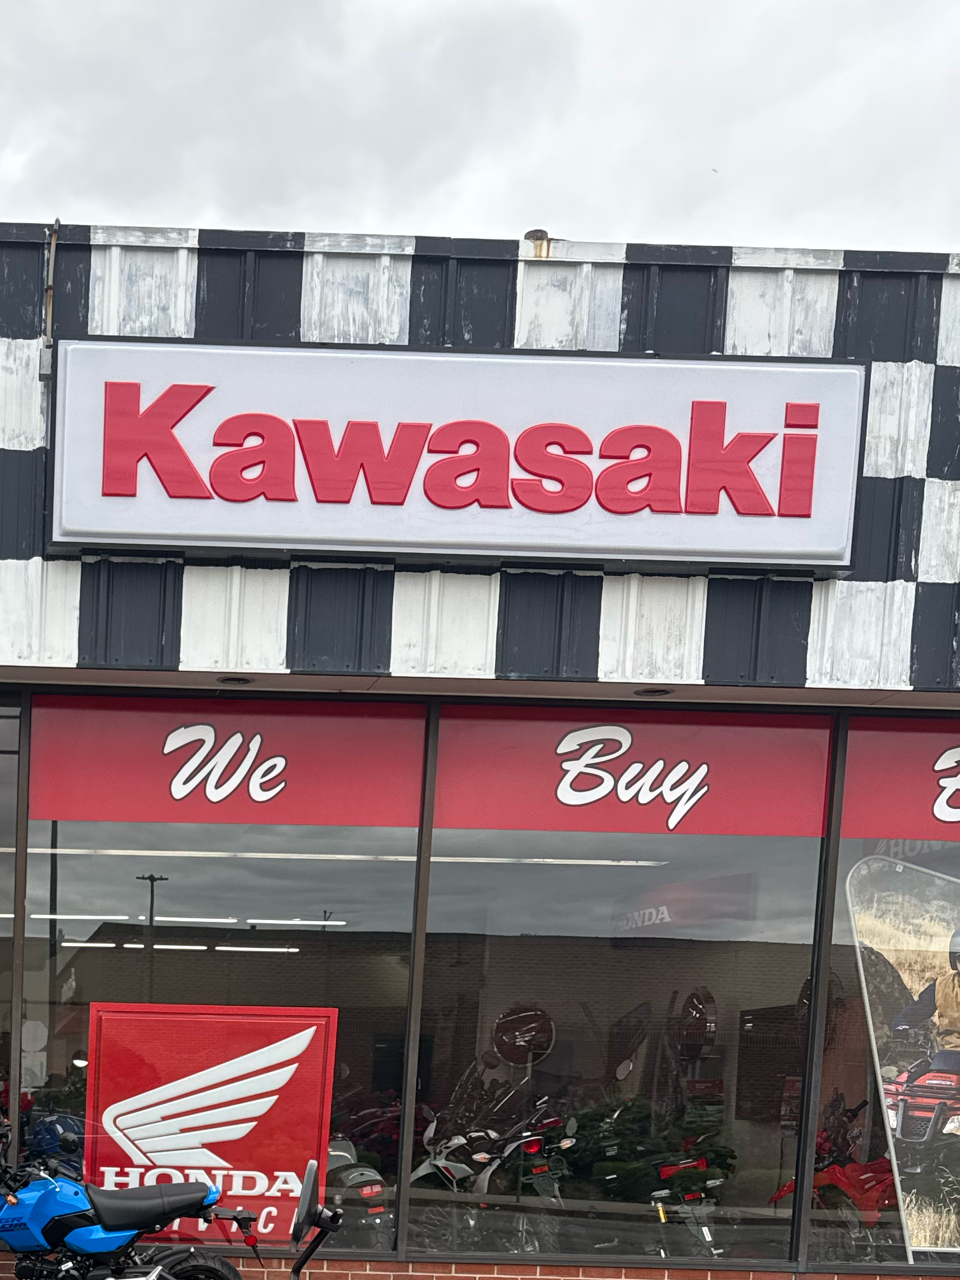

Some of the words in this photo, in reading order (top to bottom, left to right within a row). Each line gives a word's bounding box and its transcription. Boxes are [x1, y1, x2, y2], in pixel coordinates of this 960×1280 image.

[101, 380, 821, 519] Kawasaki
[162, 723, 288, 804] We
[555, 723, 710, 831] Buy
[99, 1166, 304, 1197] HONDA
